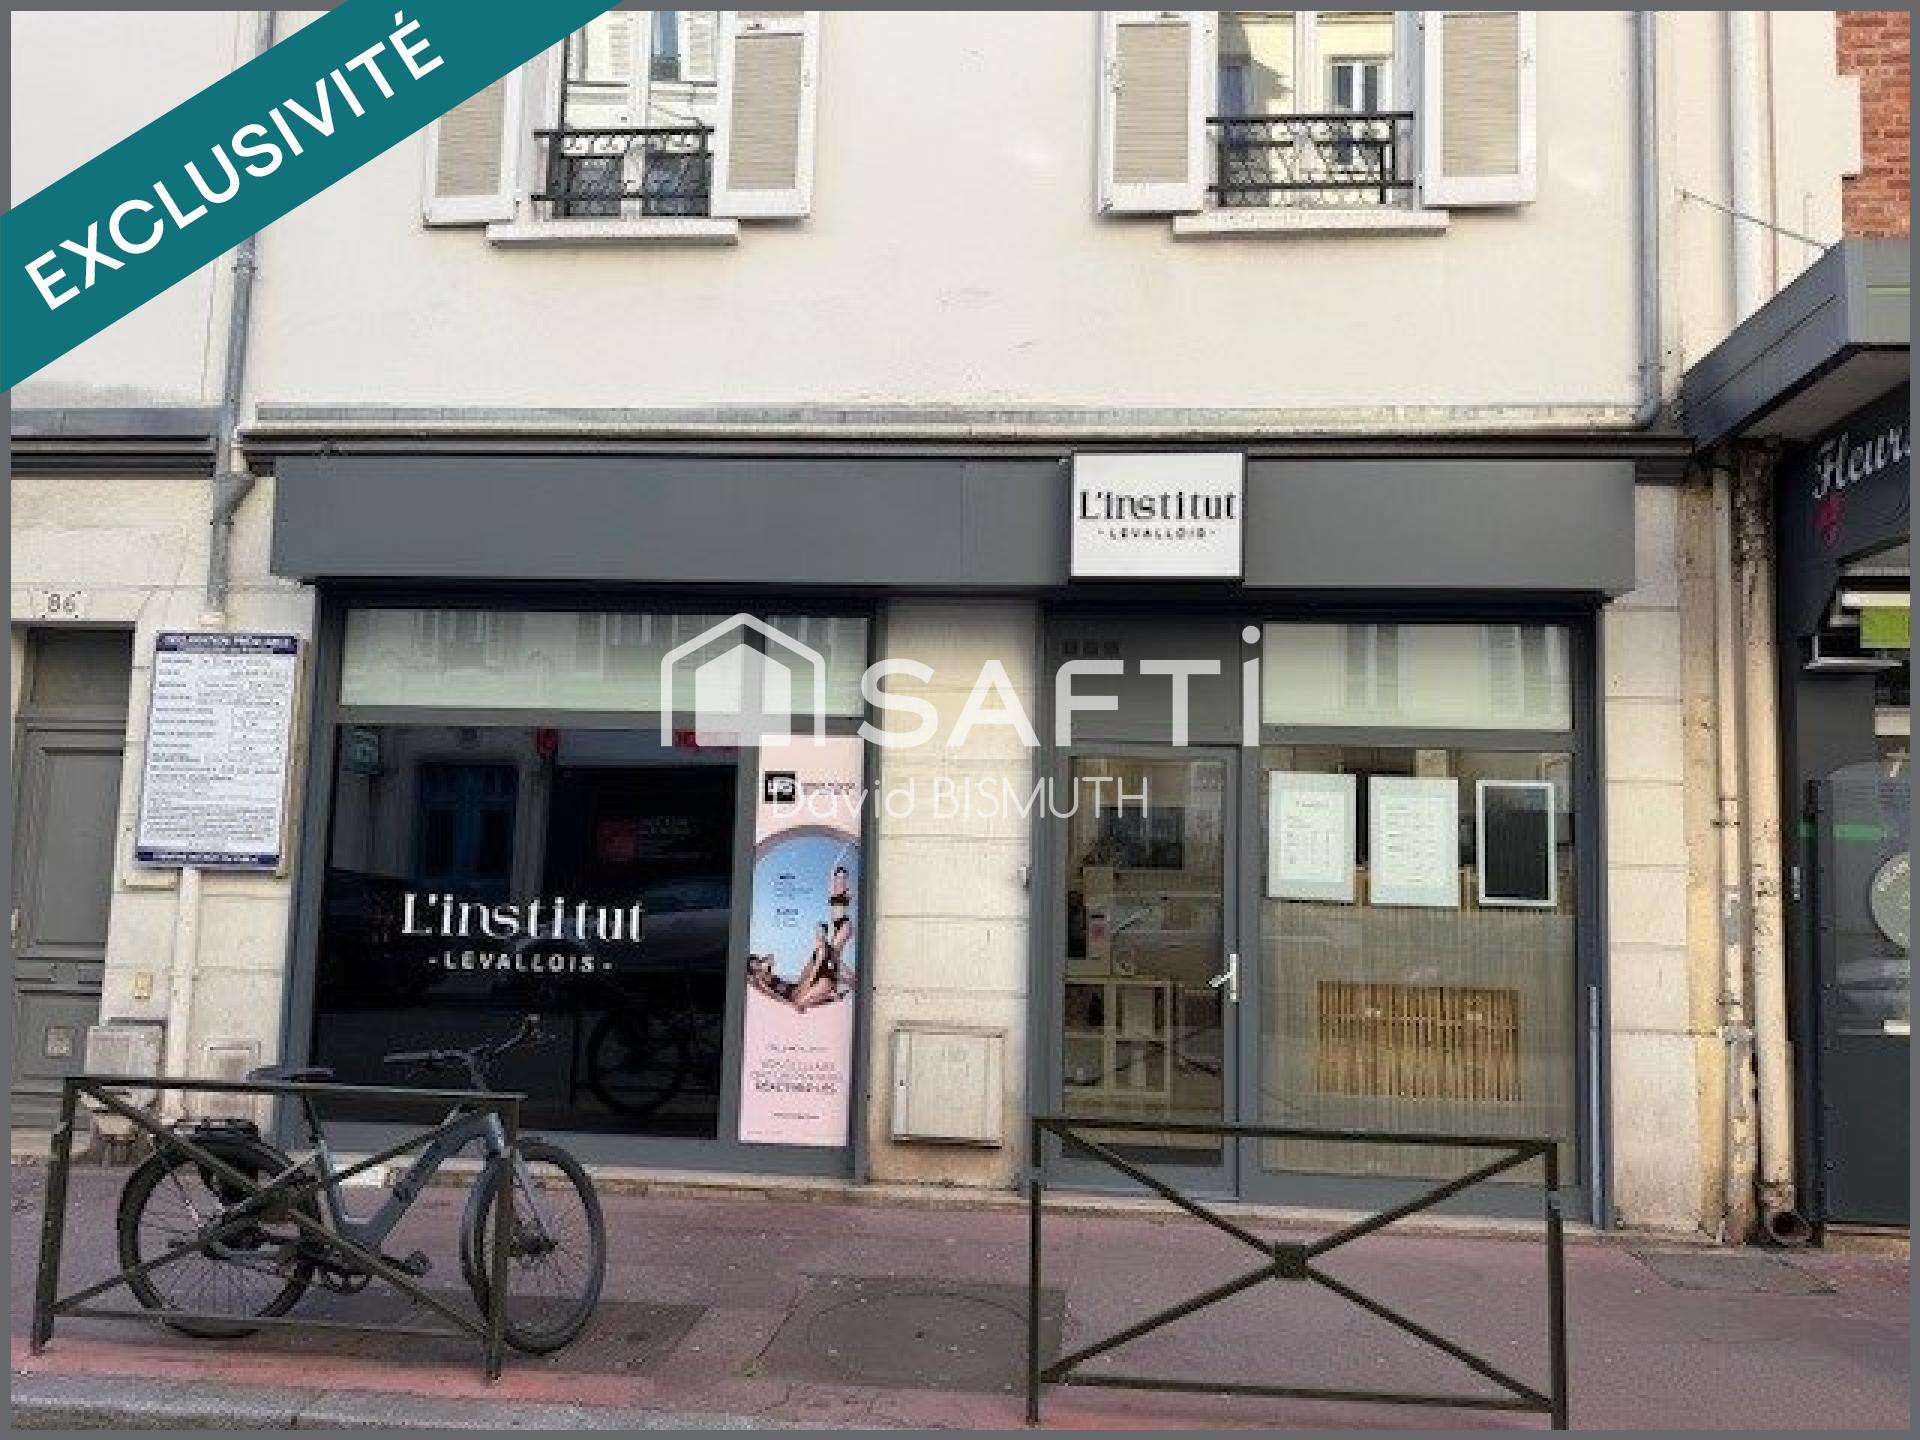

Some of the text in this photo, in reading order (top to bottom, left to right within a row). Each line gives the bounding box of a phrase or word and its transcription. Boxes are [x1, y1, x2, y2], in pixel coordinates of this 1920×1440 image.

[1811, 428, 1911, 498] Fleur
[1079, 490, 1237, 520] L'institut
[48, 593, 76, 613] 86
[402, 893, 644, 942] L'institut
